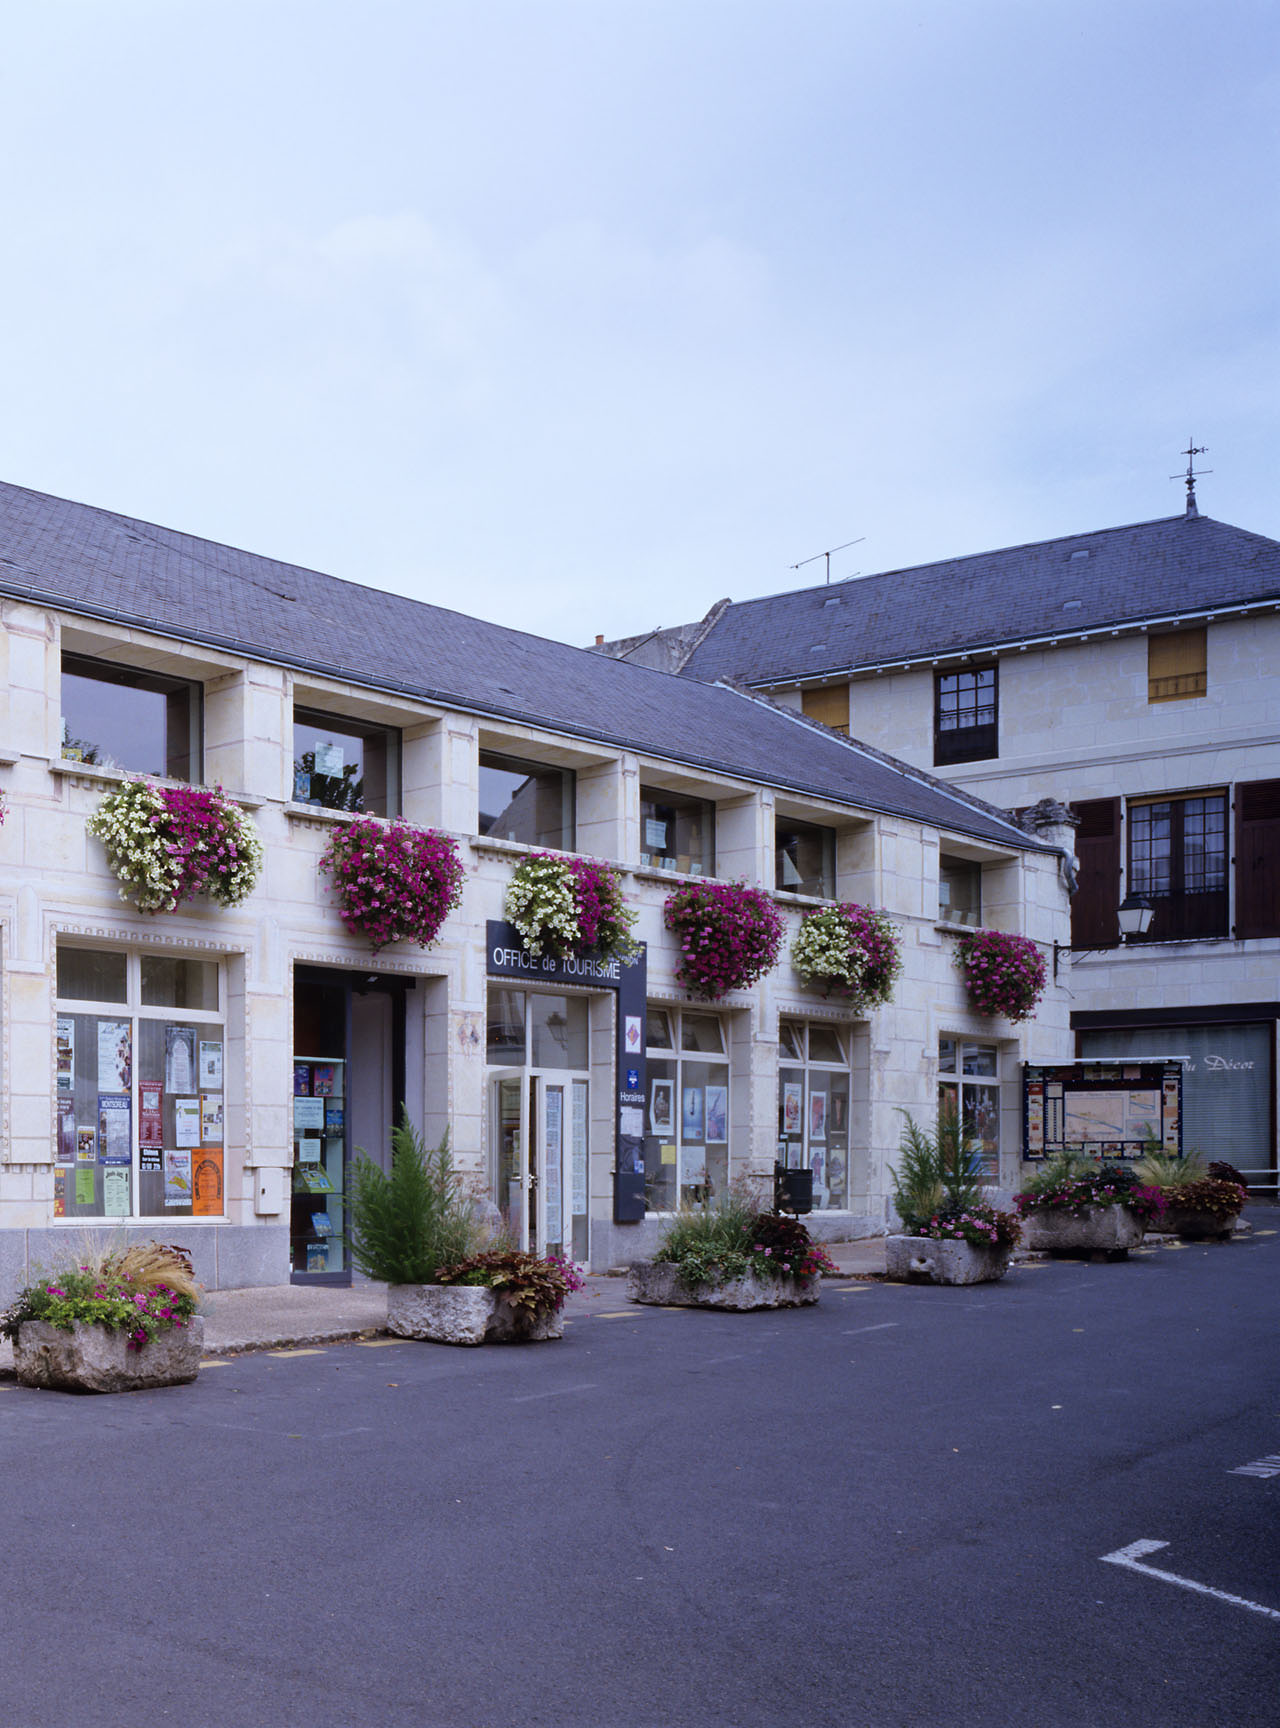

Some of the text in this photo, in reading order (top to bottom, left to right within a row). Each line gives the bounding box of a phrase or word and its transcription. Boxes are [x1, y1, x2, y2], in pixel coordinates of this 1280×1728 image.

[493, 947, 538, 970] OFFICE
[542, 954, 556, 972] de
[562, 957, 621, 980] TOURISME
[620, 1091, 646, 1103] Horaires
